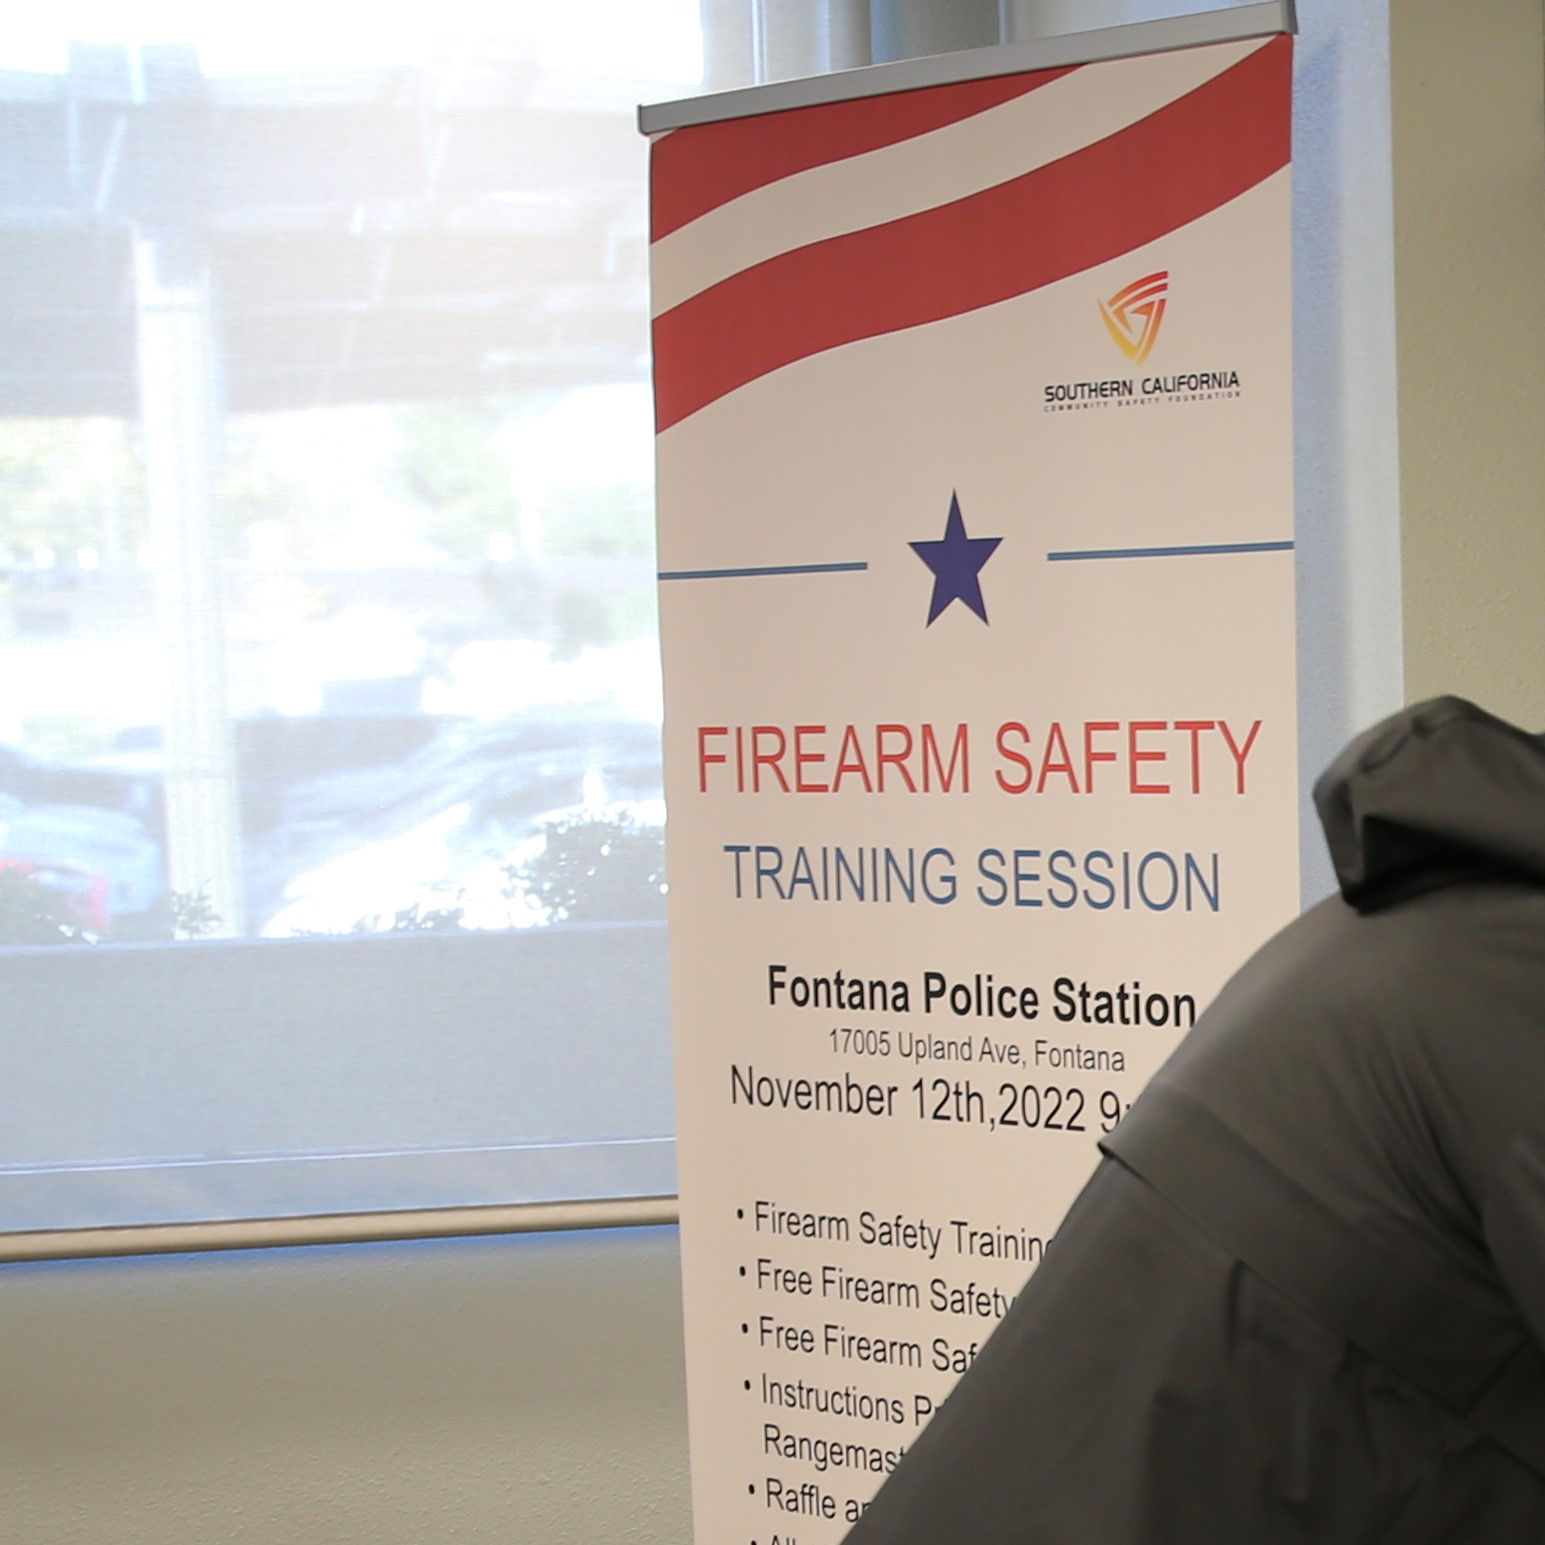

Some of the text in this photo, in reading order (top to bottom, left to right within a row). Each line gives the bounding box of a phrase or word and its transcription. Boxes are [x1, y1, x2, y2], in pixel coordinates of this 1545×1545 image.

[1044, 370, 1240, 403] SOUTHERN CALIFORNIA
[1044, 401, 1109, 413] COMMUNITY
[1168, 390, 1241, 403] FOUNDATION
[697, 719, 1263, 795] FIREARM SAFETY
[722, 844, 1220, 913] TRAINING SESSION
[767, 964, 1197, 1028] Fontana Police Station
[829, 1028, 1125, 1072] 17005 Upland Ave, Fontana
[730, 1063, 899, 1117] November
[911, 1077, 1086, 1133] 12th,2022
[754, 1200, 850, 1242] Firearm
[858, 1210, 942, 1261] Safety
[757, 1257, 813, 1296] Free
[821, 1265, 920, 1309] Firearm
[759, 1315, 815, 1354] Free
[823, 1323, 922, 1369] Firearm
[762, 1373, 905, 1424] Instructions
[765, 1477, 837, 1520] Raffle
